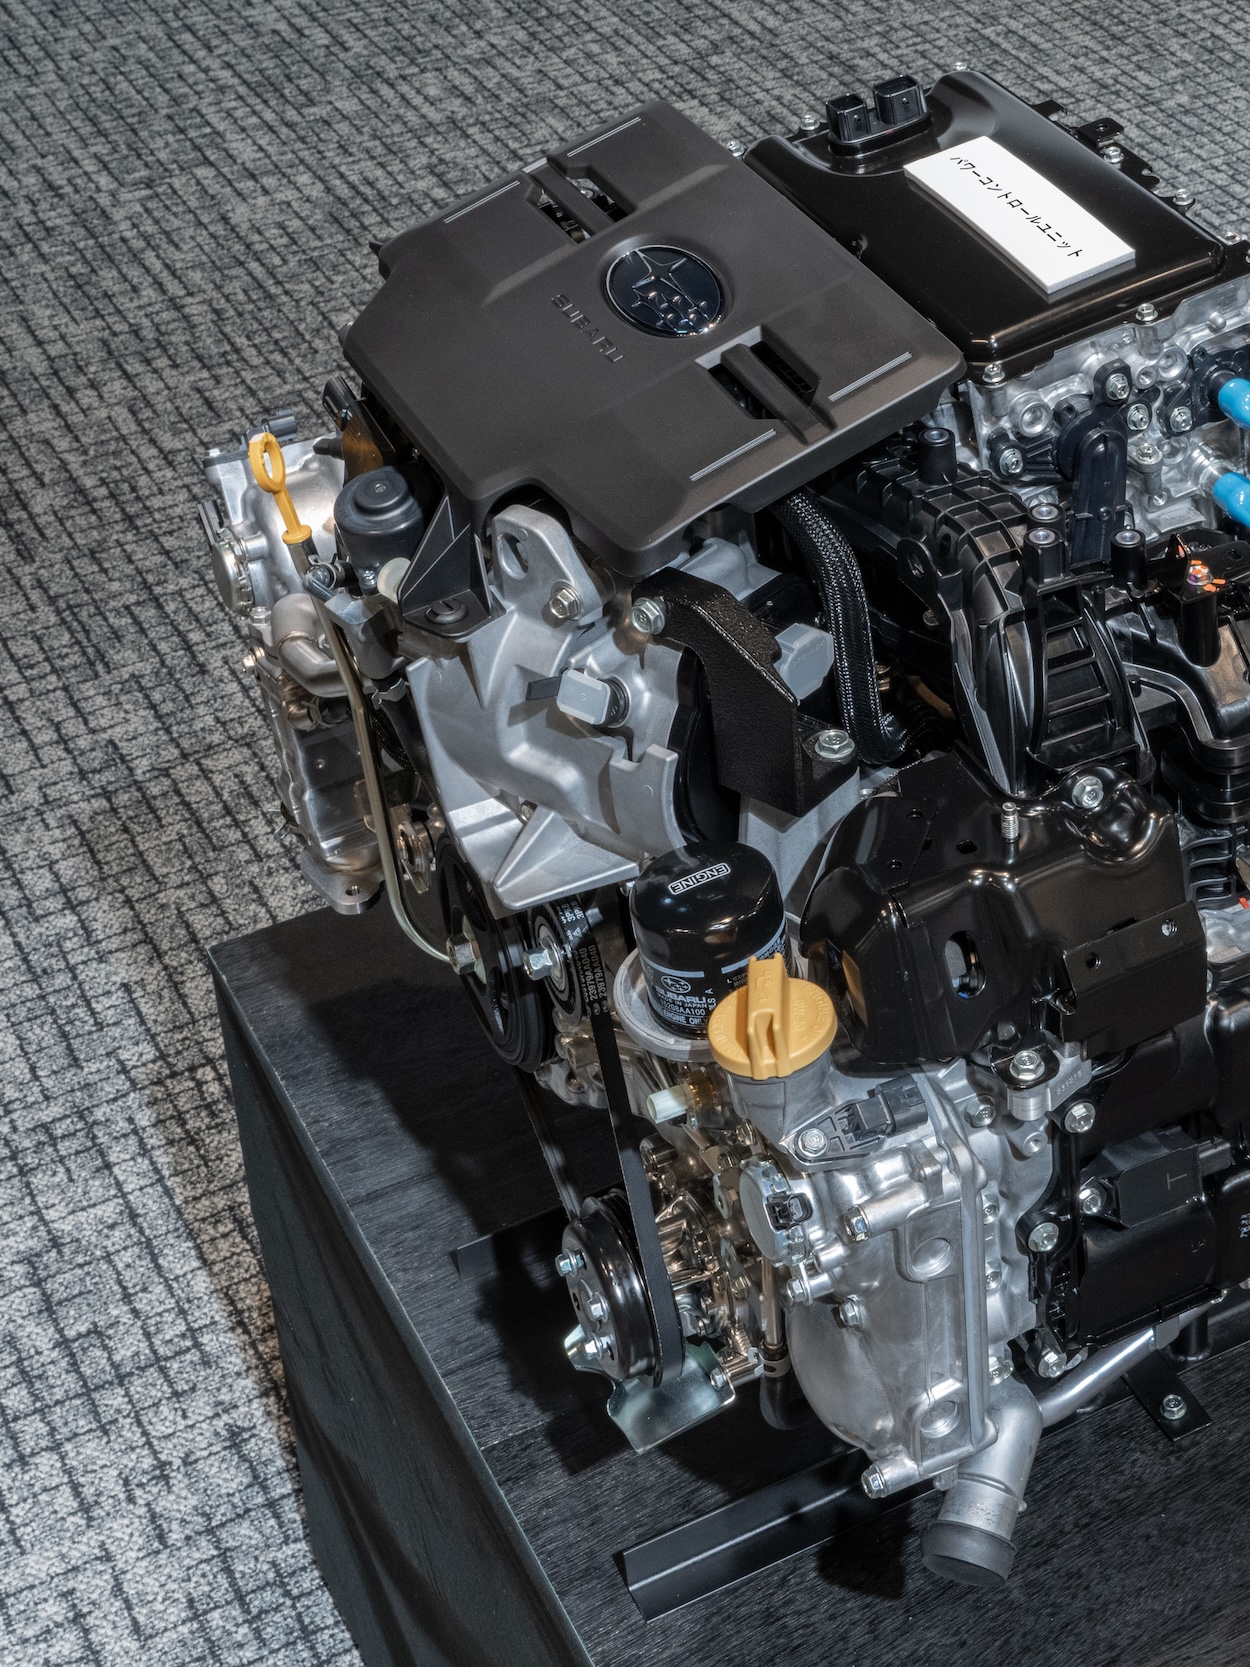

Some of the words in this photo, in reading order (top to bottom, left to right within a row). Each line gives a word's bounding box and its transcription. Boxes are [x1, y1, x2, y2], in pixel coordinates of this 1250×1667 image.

[949, 156, 1086, 259] パワーコントロールユニット
[551, 293, 624, 364] SUBARU
[671, 865, 728, 893] ENGINE
[578, 947, 598, 1001] 23979AA040
[655, 986, 707, 1004] SUBARU
[802, 983, 831, 1022] ENGINE
[662, 1008, 688, 1024] ENGINE
[791, 999, 807, 1031] 0W-20
